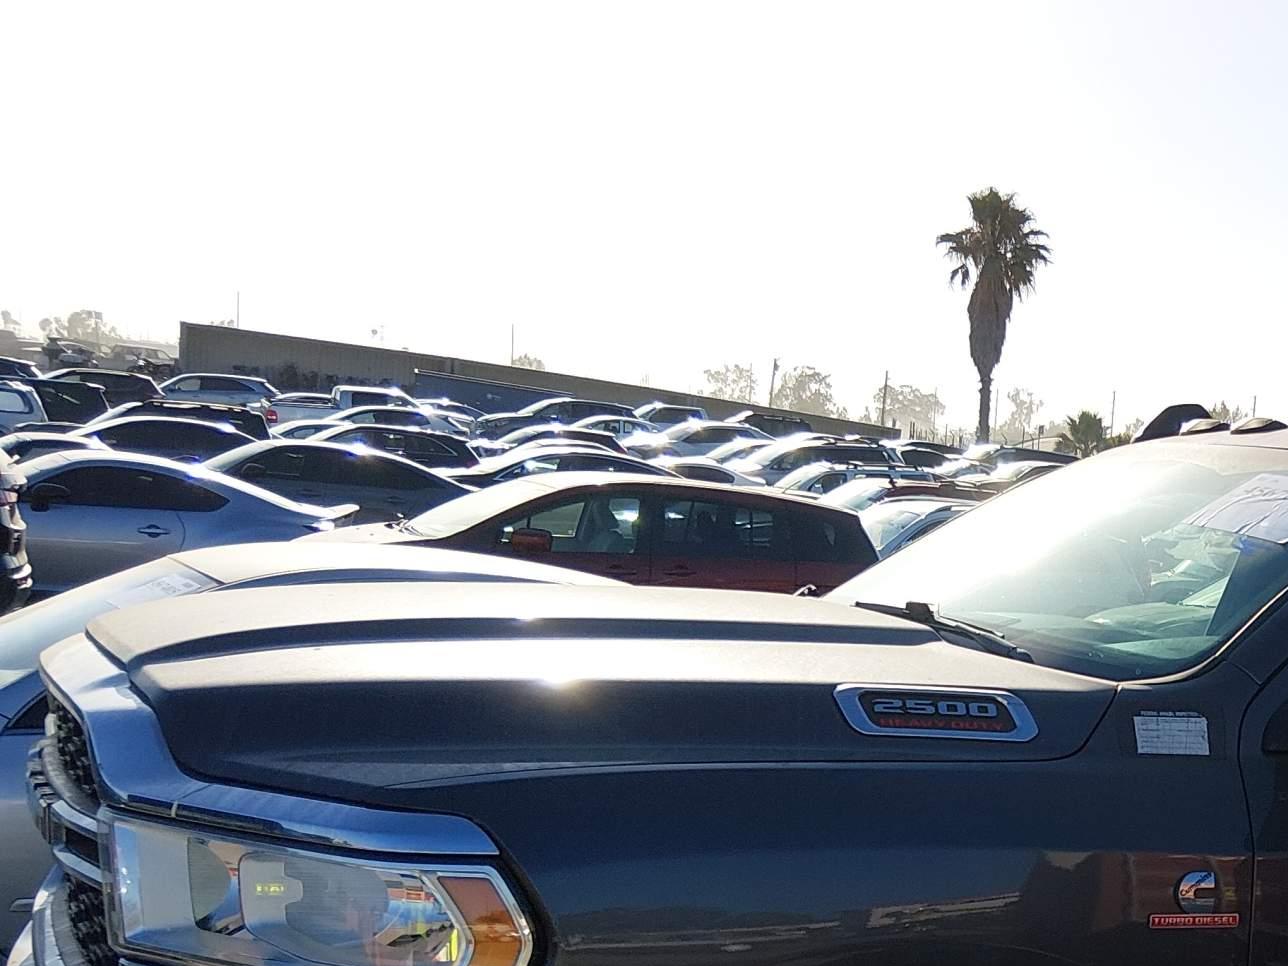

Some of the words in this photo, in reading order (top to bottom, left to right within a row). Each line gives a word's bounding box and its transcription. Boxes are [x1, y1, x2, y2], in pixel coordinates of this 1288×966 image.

[871, 698, 998, 717] 2500
[879, 718, 945, 729] HEAVY
[951, 720, 1004, 731] DUTY
[1153, 917, 1195, 926] TURBO
[1196, 916, 1237, 925] DIESEL
